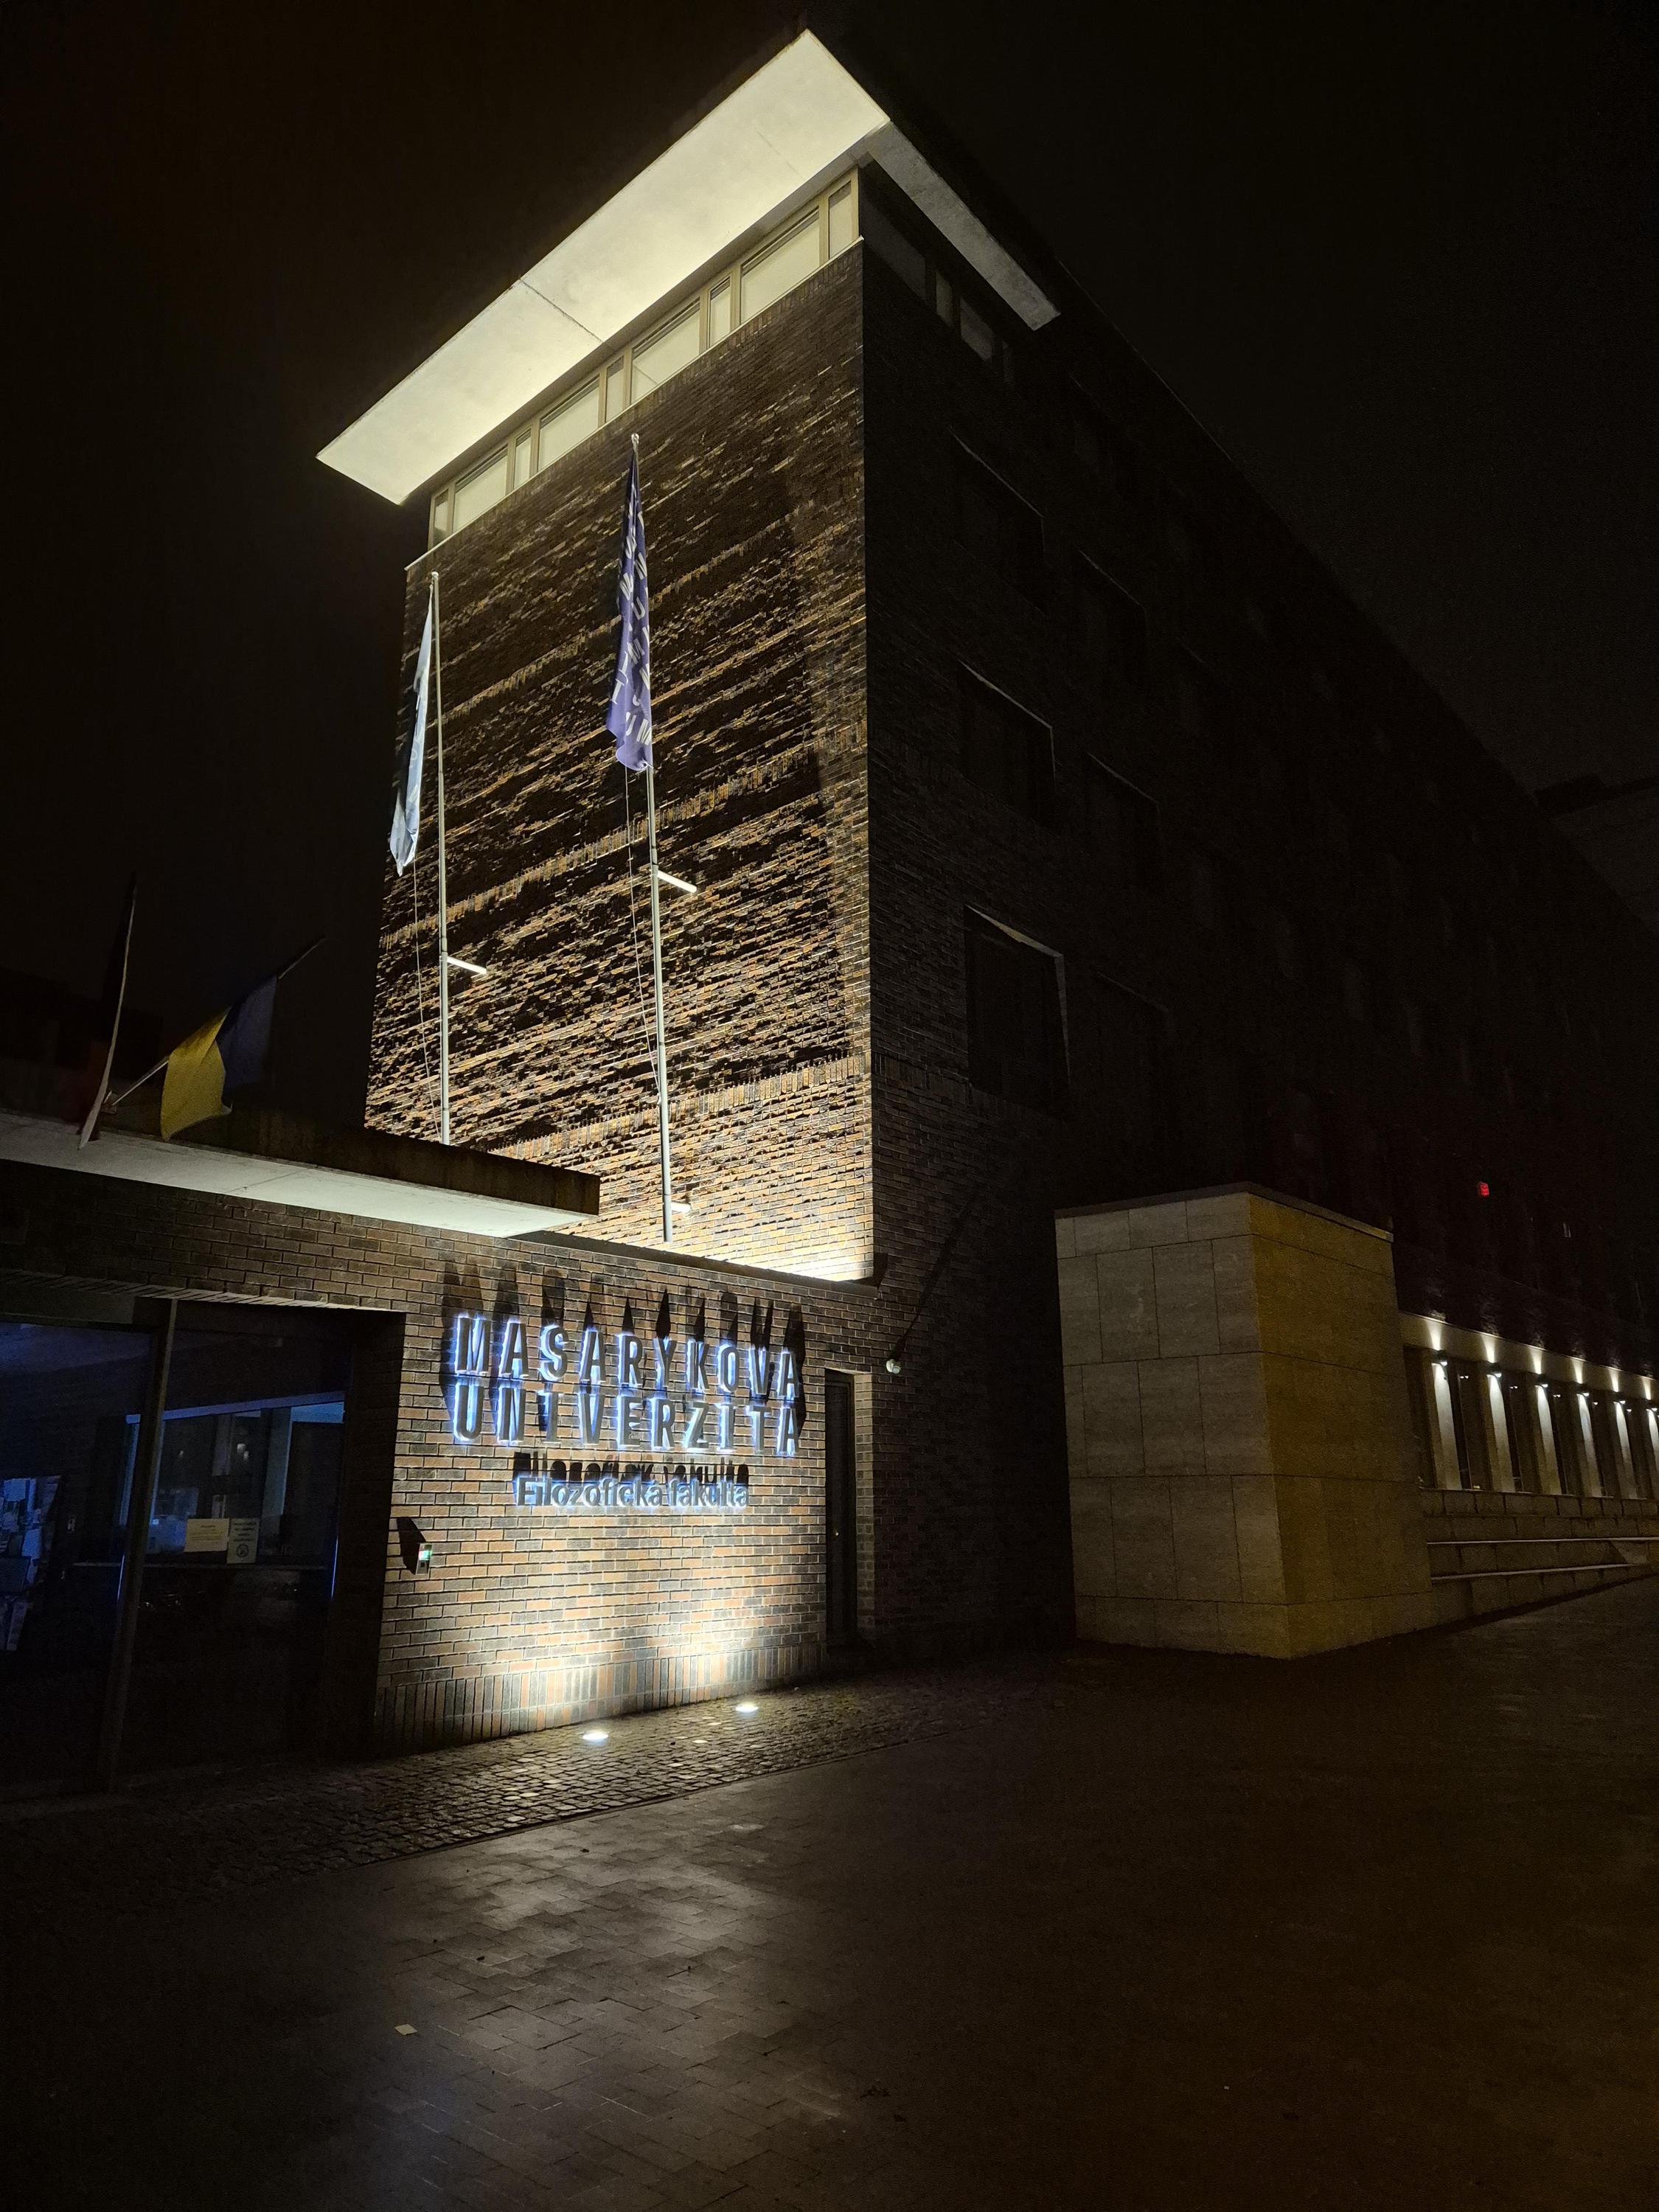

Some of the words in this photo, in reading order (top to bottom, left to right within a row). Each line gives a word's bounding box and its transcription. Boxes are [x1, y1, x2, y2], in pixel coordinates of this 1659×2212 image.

[456, 1315, 800, 1398] MASARYKOVA
[453, 1382, 800, 1455] UNIVERZITA
[516, 1475, 663, 1506] Filozofická
[669, 1477, 750, 1506] fakulta
